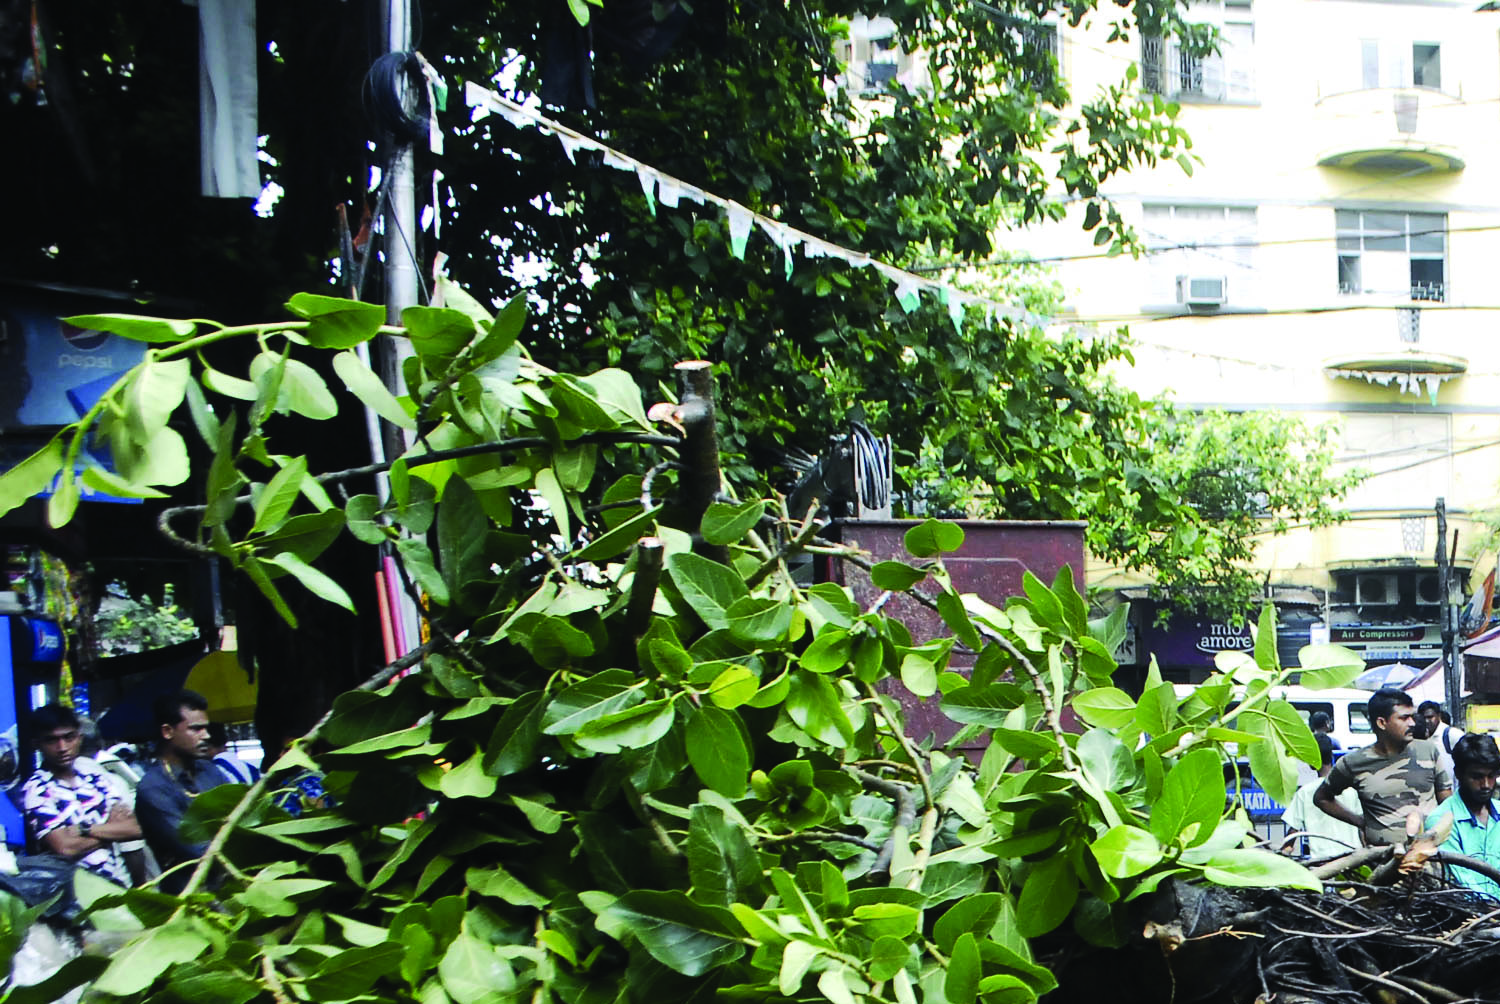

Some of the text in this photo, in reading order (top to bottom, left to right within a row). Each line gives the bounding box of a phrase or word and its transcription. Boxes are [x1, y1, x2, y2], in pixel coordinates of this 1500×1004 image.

[58, 353, 113, 369] pepsi
[1211, 621, 1243, 636] mio
[1341, 630, 1414, 640] Air Compressors
[1200, 636, 1253, 648] amore
